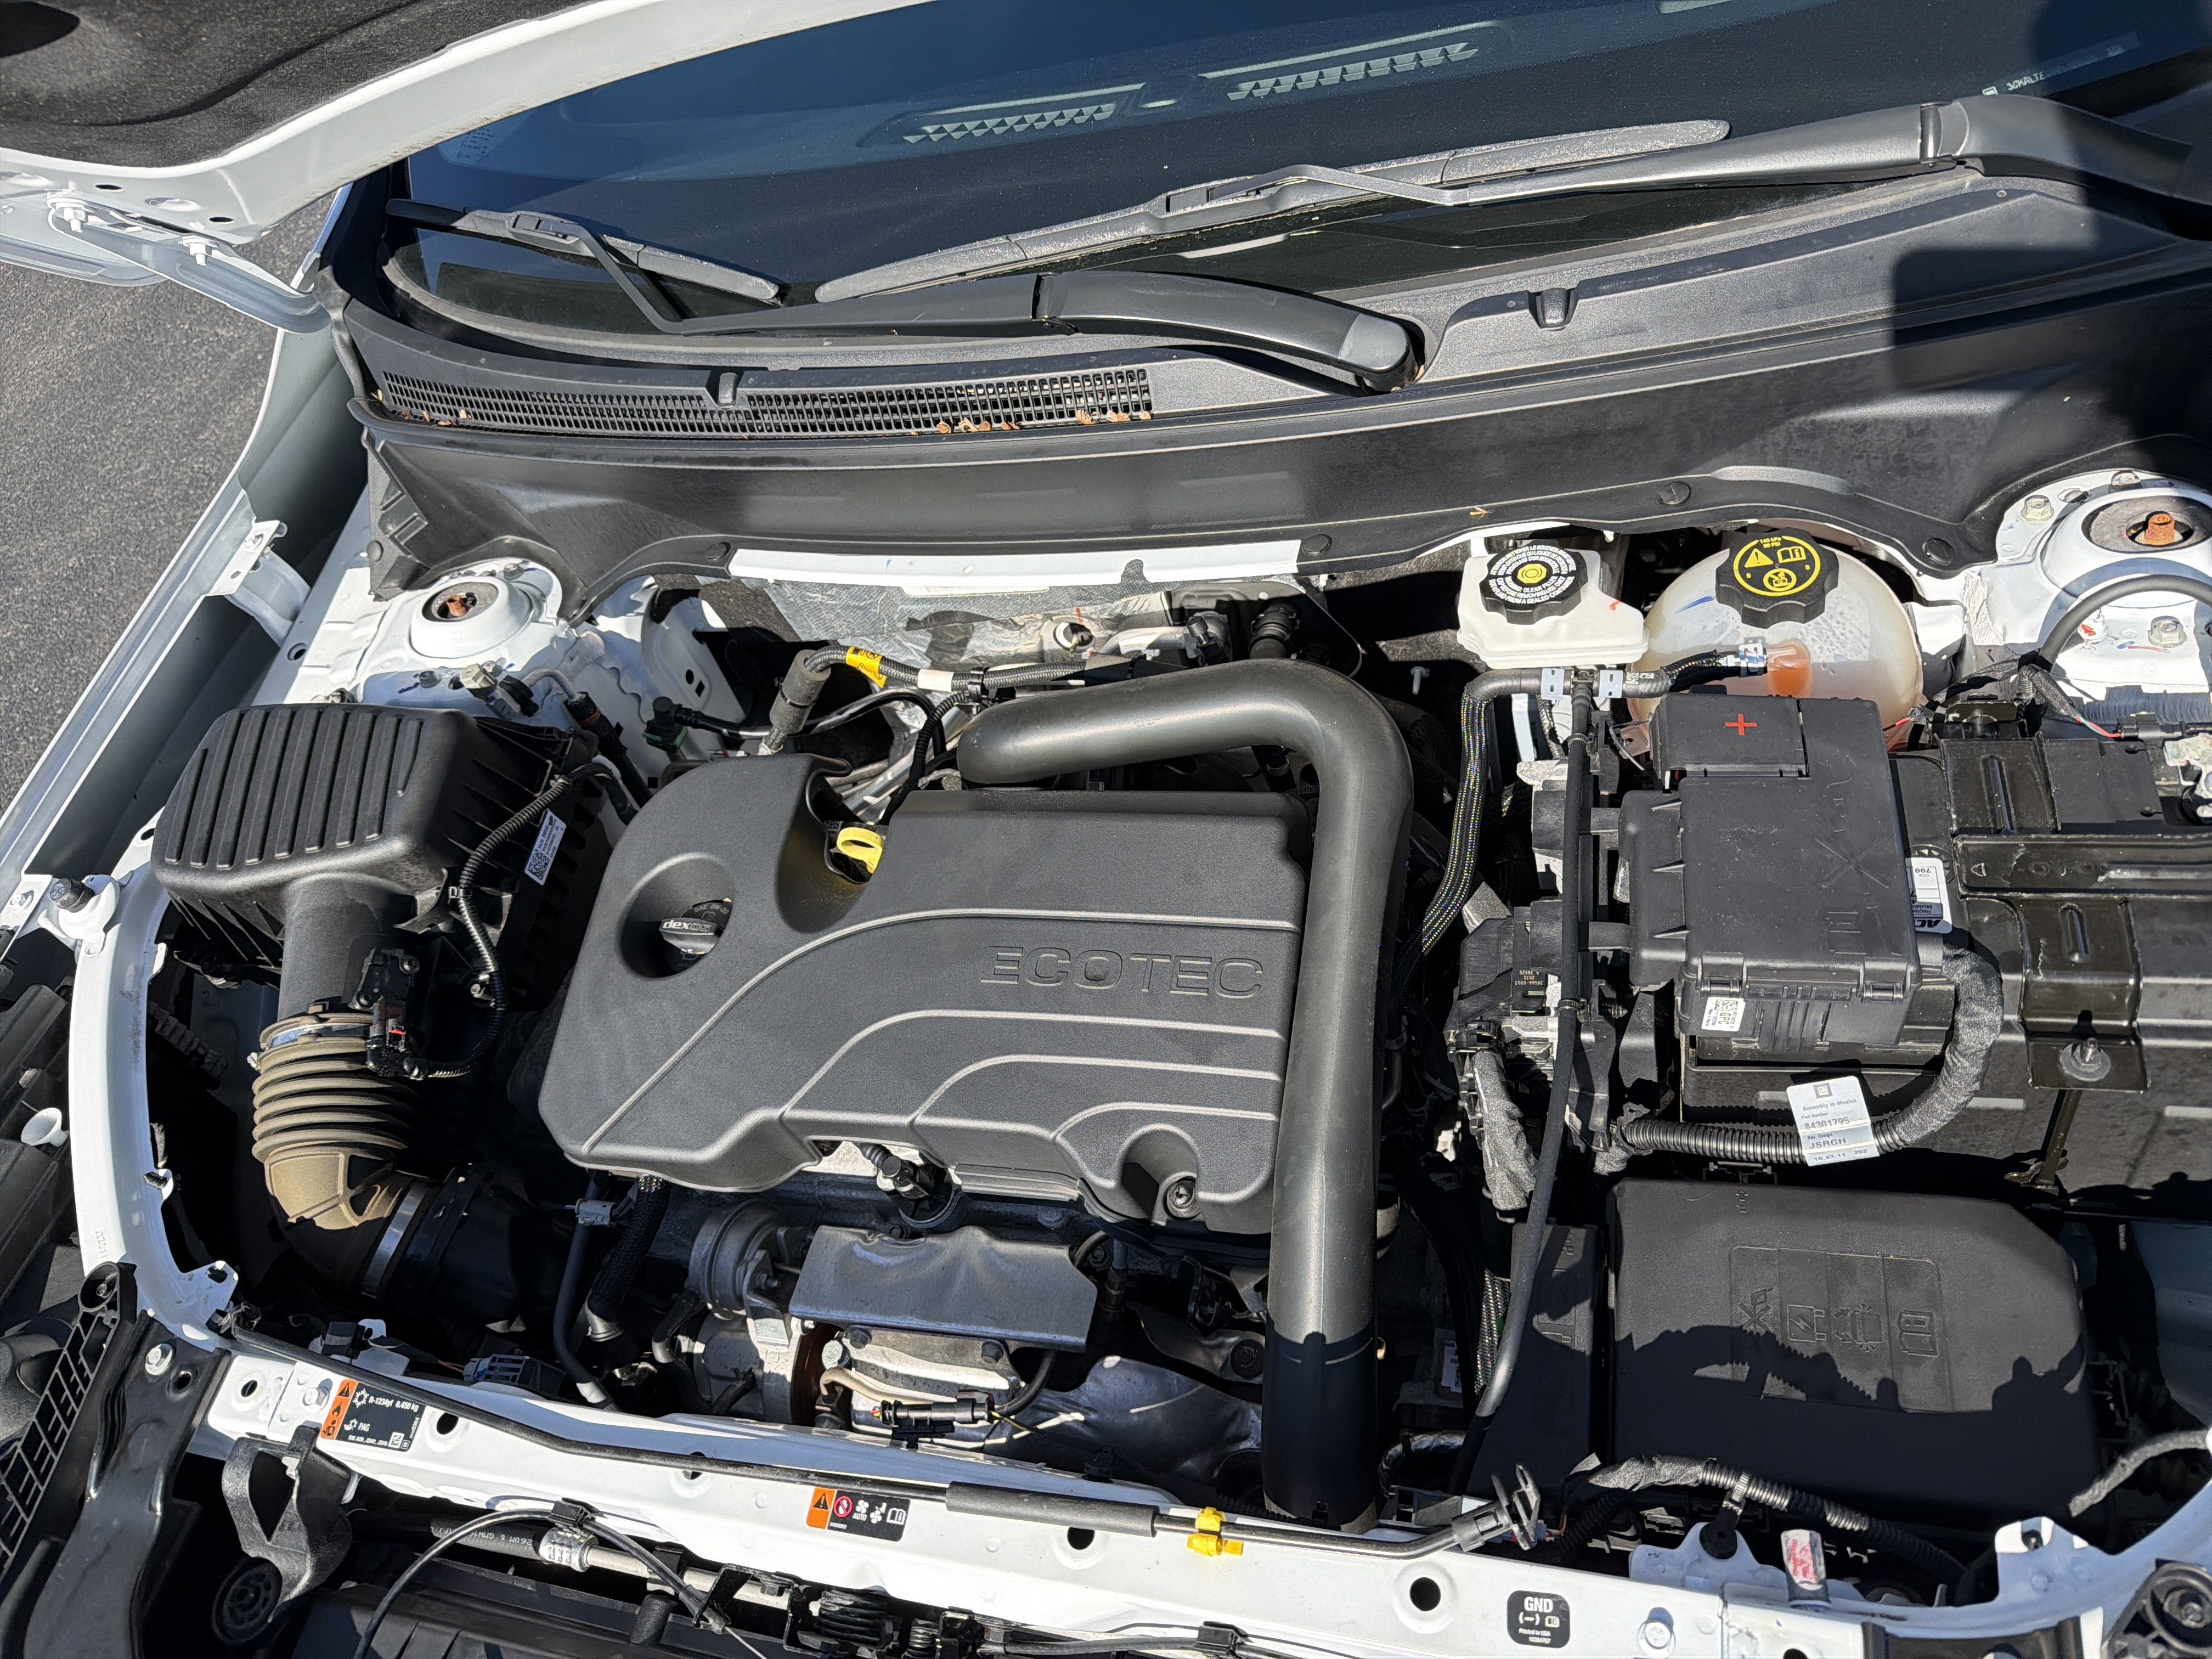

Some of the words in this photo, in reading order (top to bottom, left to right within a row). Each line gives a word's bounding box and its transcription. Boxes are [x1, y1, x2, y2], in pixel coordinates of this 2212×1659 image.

[694, 904, 708, 913] SAE
[710, 904, 730, 915] 0W-20
[663, 919, 712, 932] dexos
[1915, 919, 1941, 928] AC
[980, 945, 1263, 1000] ECOTEC
[1803, 1103, 1828, 1111] Assembly
[1804, 1117, 1850, 1130] 84301795
[1809, 1138, 1847, 1149] JSRGH
[369, 1396, 394, 1408] R-1234yf
[411, 1404, 419, 1413] kg
[358, 1423, 370, 1432] PAG
[853, 1513, 867, 1521] AUTO
[1524, 1596, 1553, 1613] GND
